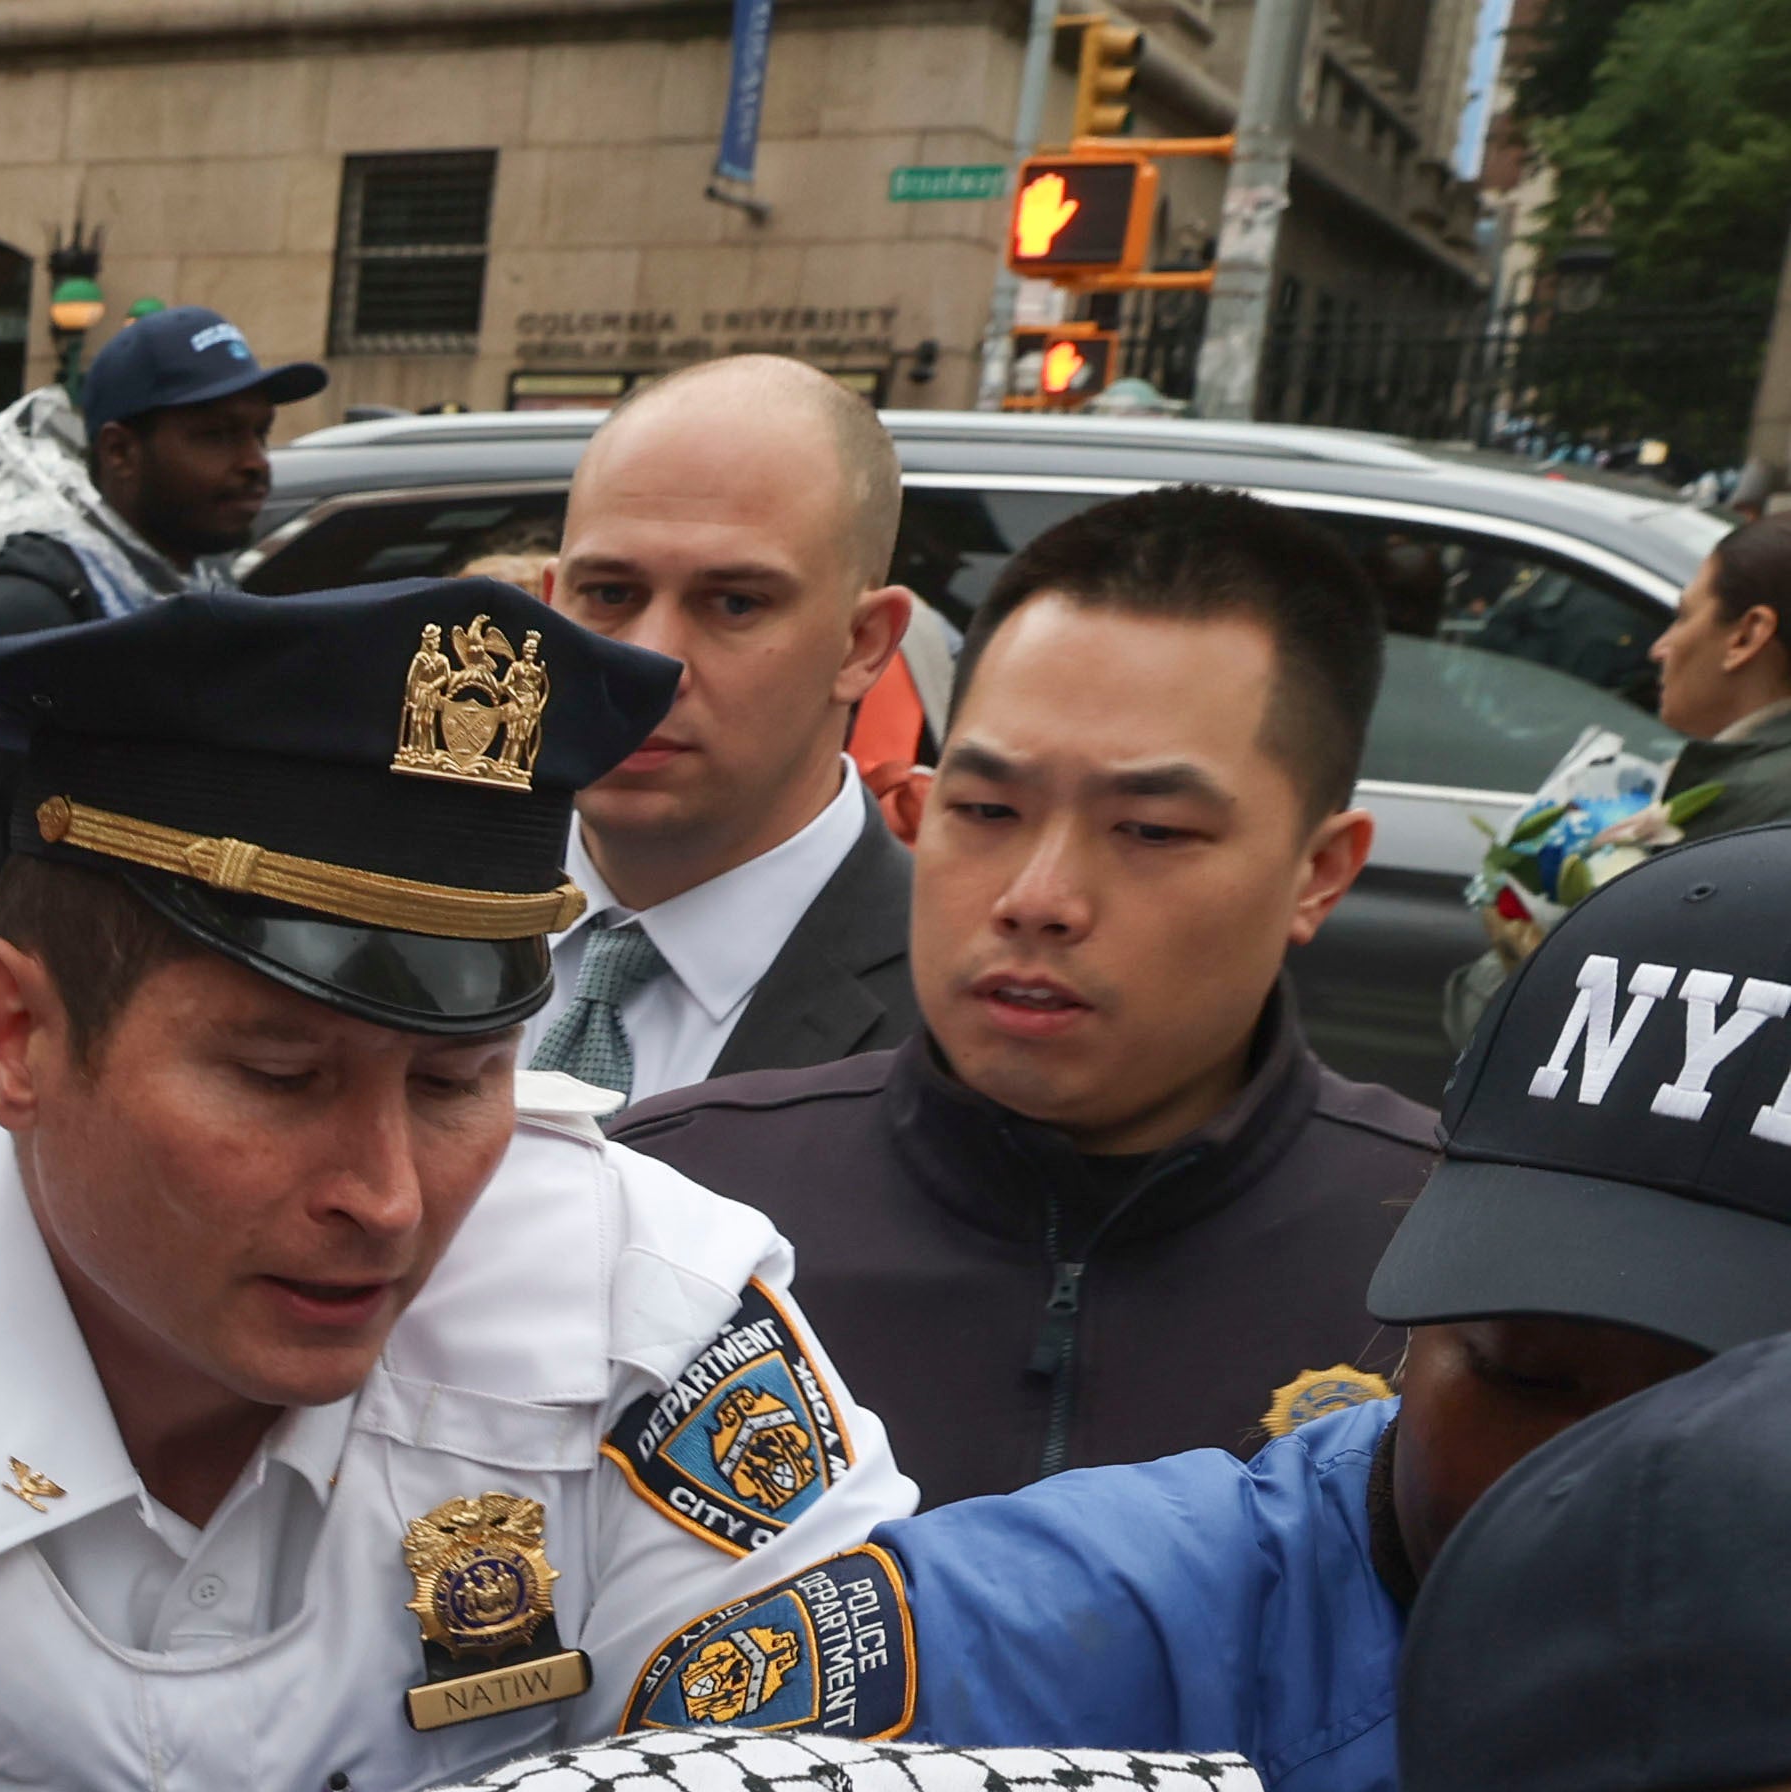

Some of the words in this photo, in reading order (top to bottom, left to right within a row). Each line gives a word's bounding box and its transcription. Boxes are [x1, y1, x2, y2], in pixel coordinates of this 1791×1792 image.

[636, 1318, 785, 1463] DEPARTMENT
[793, 1356, 840, 1448] YORK
[669, 1486, 747, 1538] CITY
[751, 1527, 775, 1549] O
[681, 1601, 749, 1648] CITY
[794, 1570, 856, 1730] DEPARTMENT
[840, 1577, 888, 1674] POLICE
[444, 1666, 552, 1717] NATIW
[644, 1655, 672, 1693] OF
